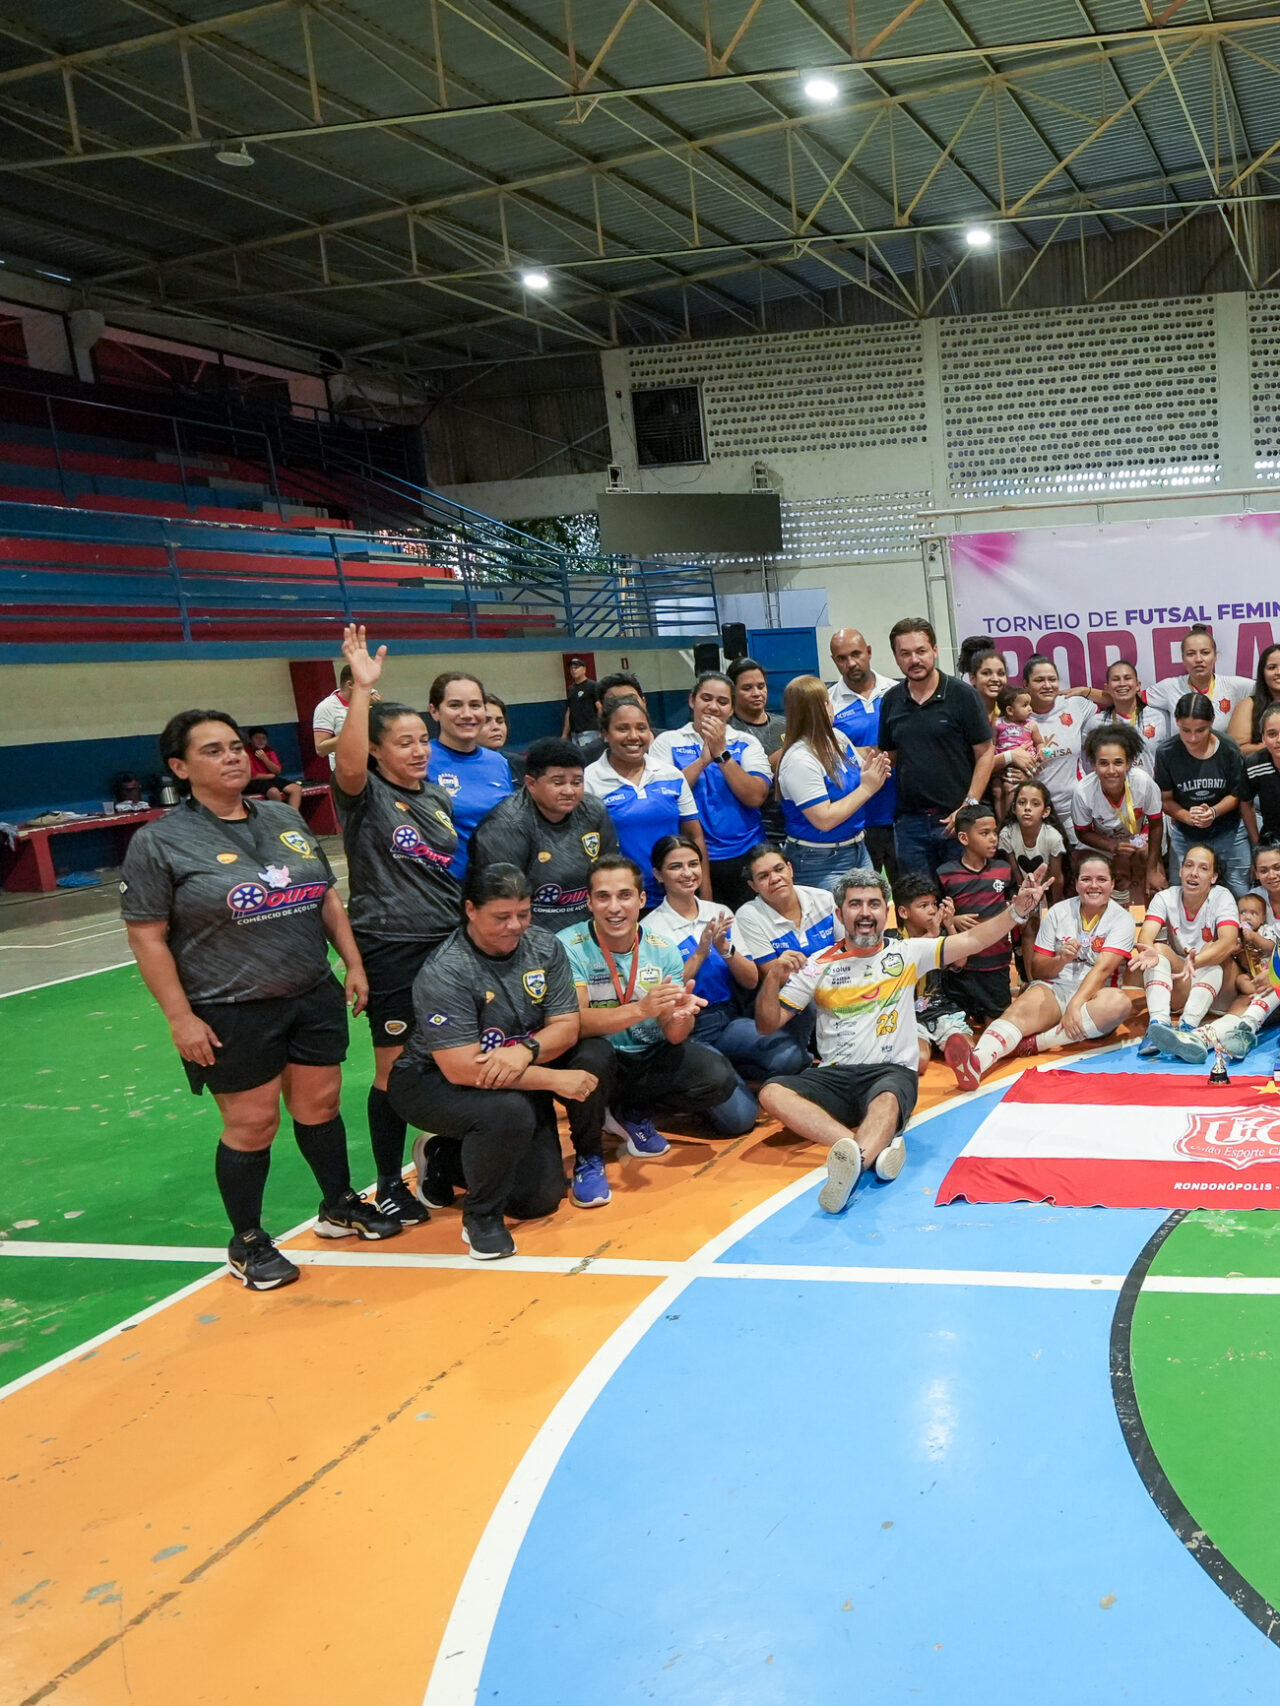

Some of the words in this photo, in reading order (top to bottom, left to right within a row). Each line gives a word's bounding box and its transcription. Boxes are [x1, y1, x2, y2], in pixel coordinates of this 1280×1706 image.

[982, 613, 1081, 633] TORNEIO
[1088, 611, 1118, 627] DE
[1126, 605, 1212, 625] FUTSAL
[237, 911, 281, 925] COMÉRCIO
[282, 909, 292, 917] DE
[876, 1009, 898, 1037] 23
[1224, 1146, 1265, 1158] Esporte
[1174, 1182, 1272, 1191] RONDONÓPOLIS
